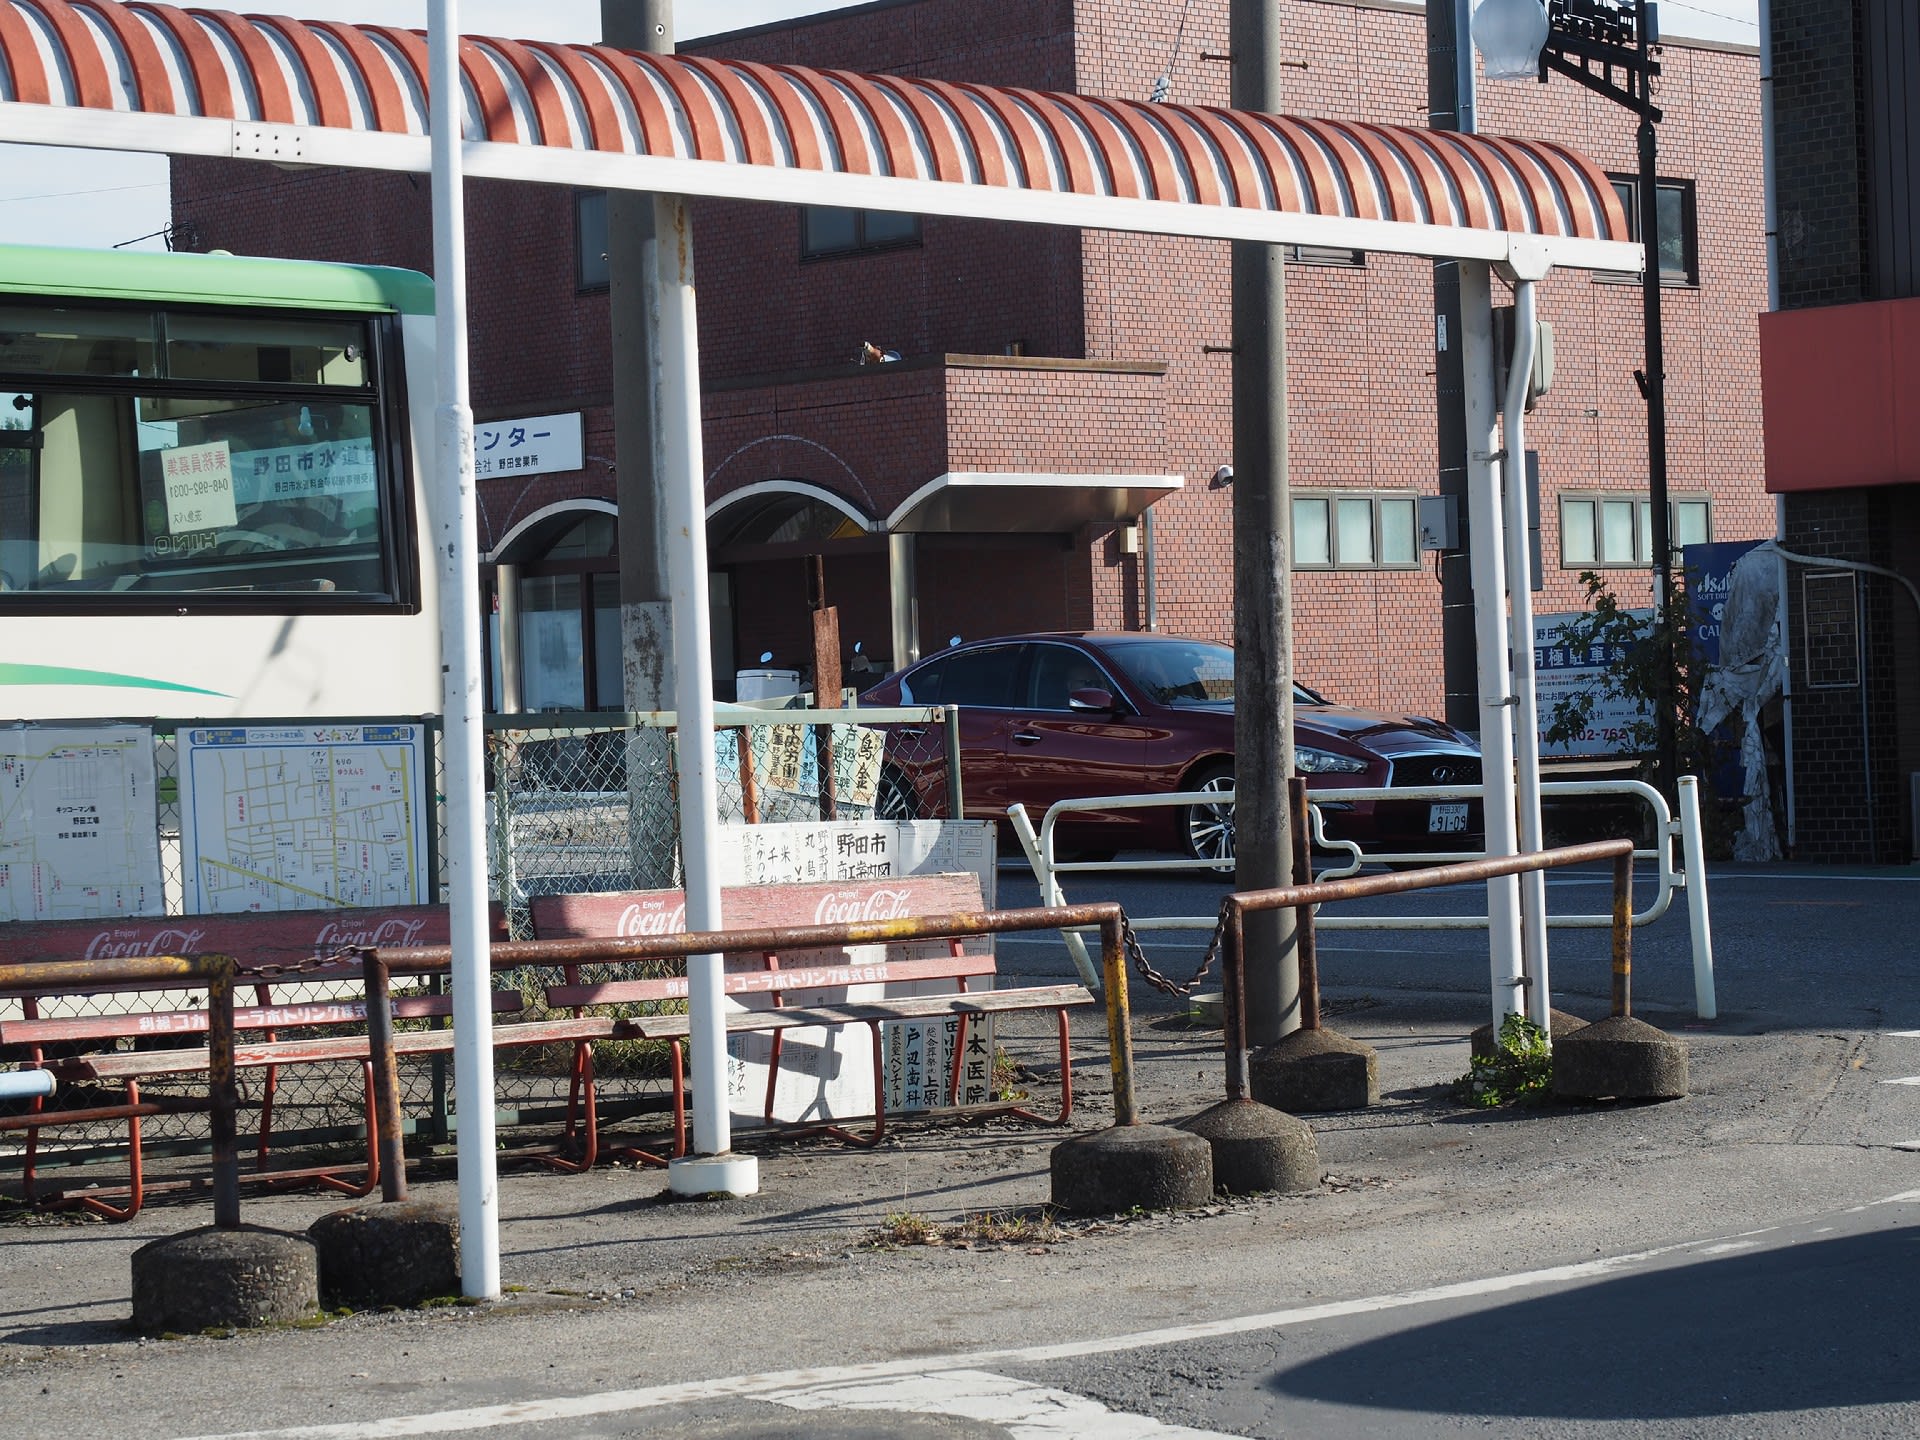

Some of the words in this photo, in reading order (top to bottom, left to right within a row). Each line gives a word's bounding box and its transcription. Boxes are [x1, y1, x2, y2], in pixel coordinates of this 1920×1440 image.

[474, 428, 551, 451] ンター
[499, 455, 539, 469] 野田営業所
[337, 767, 365, 776] ゆうえんち
[1437, 815, 1466, 831] 91-09
[837, 832, 886, 857] 野田市
[838, 888, 859, 899] Enjoy!
[642, 900, 665, 910] Enjoy!
[341, 919, 366, 929] Enjoy!
[114, 929, 140, 939] Enjoy!
[906, 1027, 921, 1106] 戸辺歯科
